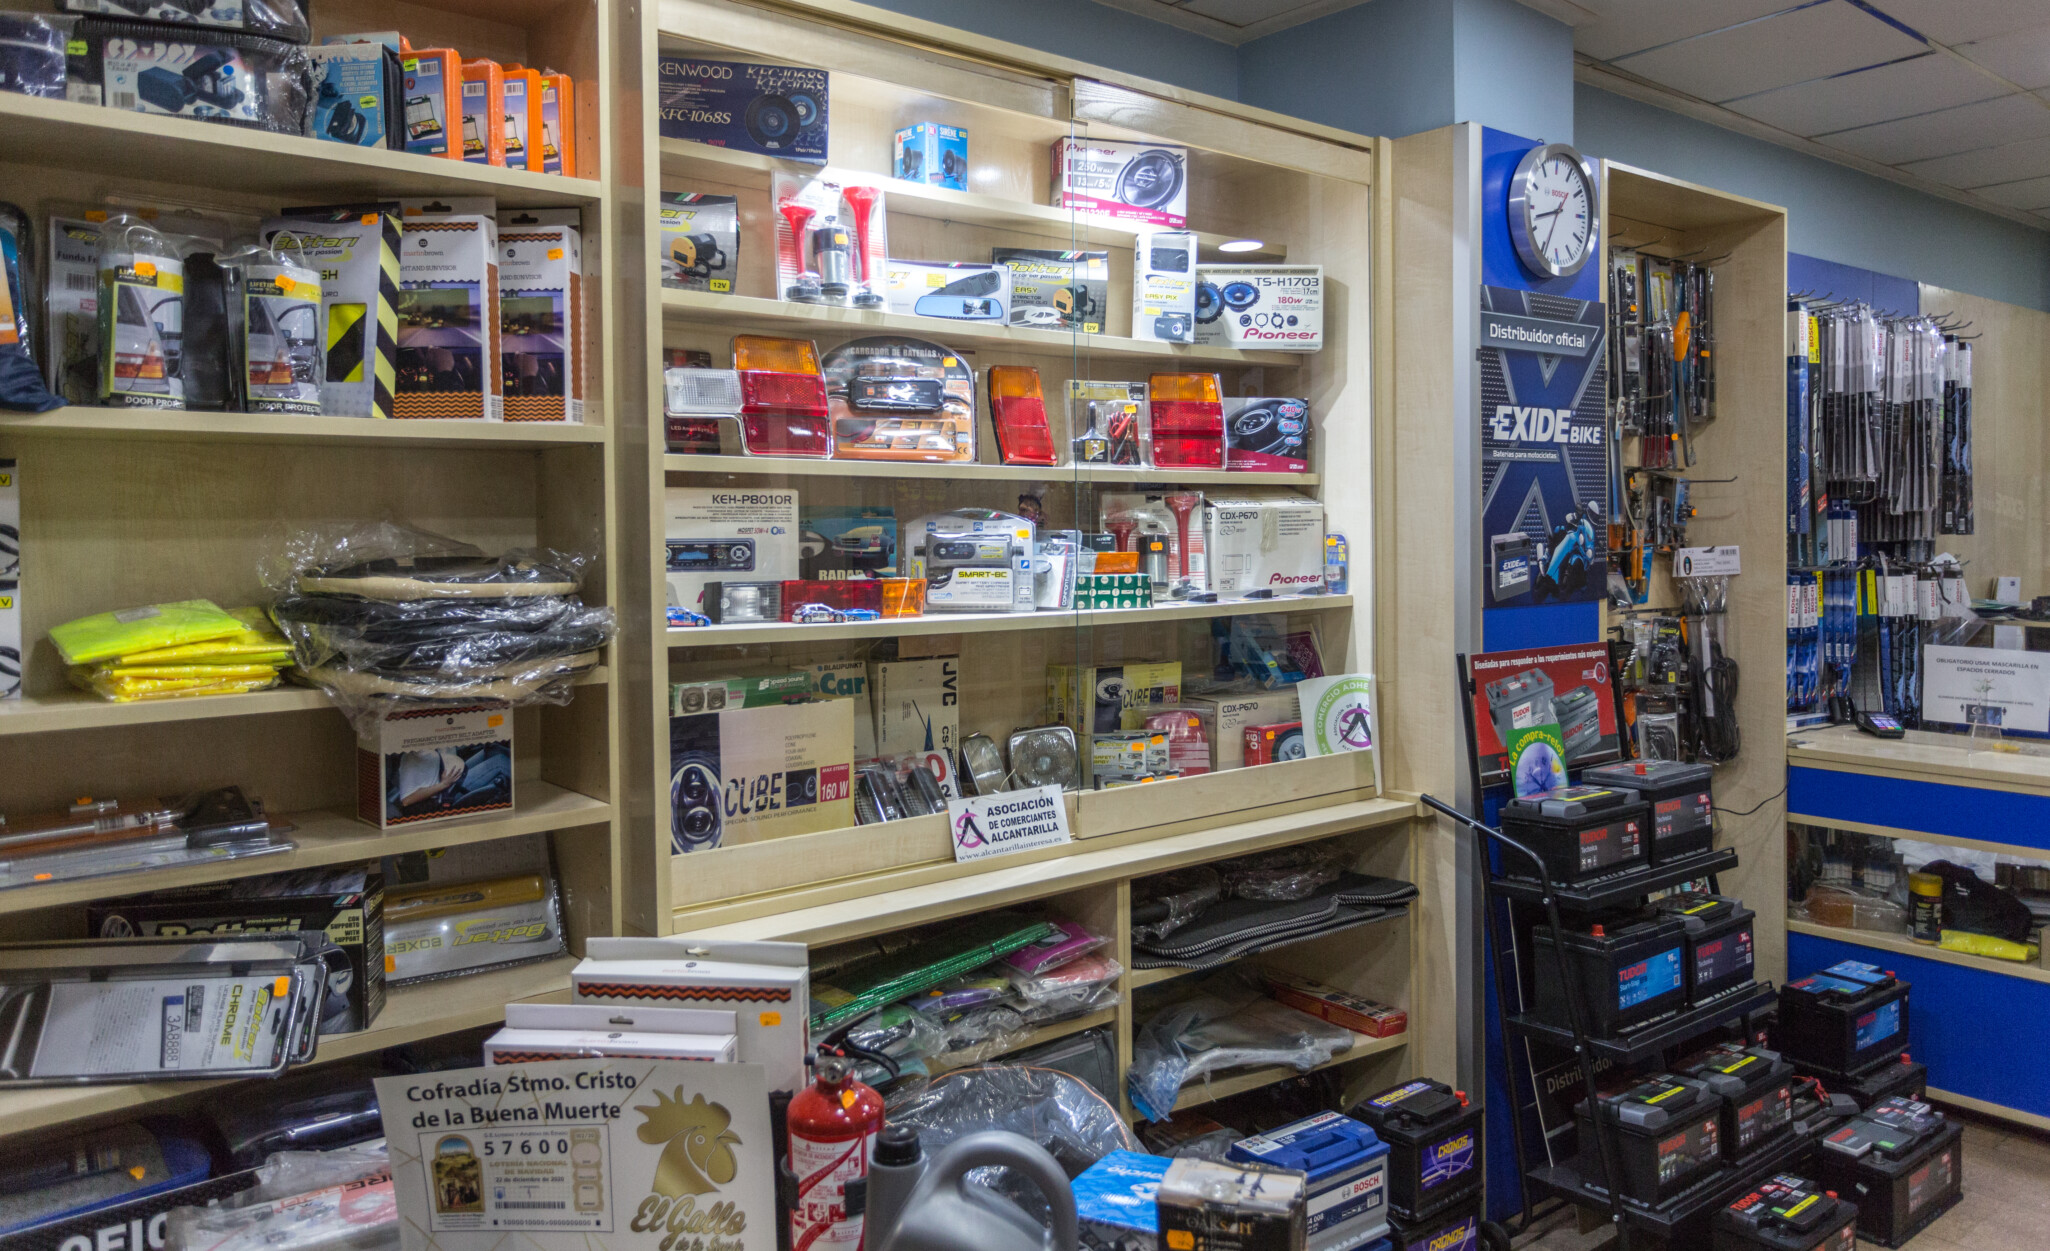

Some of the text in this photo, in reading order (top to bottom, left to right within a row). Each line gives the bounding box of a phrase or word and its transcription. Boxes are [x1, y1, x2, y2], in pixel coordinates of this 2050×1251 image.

[659, 62, 733, 80] KENWOOD
[746, 66, 827, 84] KFC-1068S
[659, 108, 732, 124] KFC-1068S
[275, 235, 359, 249] Bottari
[57, 252, 85, 263] Funda
[1254, 277, 1319, 287] TS-H1703
[1243, 328, 1318, 339] Pioneer
[1489, 323, 1585, 348] Distribuidor oficial
[850, 347, 890, 356] CARGADOR
[125, 396, 153, 406] DOOR
[259, 402, 282, 411] DOOR
[1489, 405, 1600, 444] EXIDE BIKE
[1527, 451, 1557, 459] motocicletas
[712, 495, 792, 505] KEH-P8010R
[1220, 512, 1258, 520] CDX-P670
[1503, 560, 1520, 570] EXIDE
[1269, 573, 1322, 585] Pioneer
[824, 663, 863, 671] BLAUPUNKT
[1474, 660, 1499, 670] Diseñadas
[1500, 659, 1510, 668] para
[1510, 656, 1533, 666] responder
[1545, 652, 1577, 663] requerimientos
[1578, 651, 1586, 659] más
[1586, 650, 1606, 659] exigentes
[820, 673, 865, 695] Car
[943, 662, 957, 706] JVC
[1123, 687, 1149, 708] CUBE
[1222, 702, 1258, 713] CDX-P670
[1317, 688, 1341, 736] COMERCIO
[1513, 706, 1530, 718] TUDOR
[404, 736, 437, 744] PREGNANCY
[1563, 723, 1583, 740] TUDOR
[1509, 754, 1518, 766] La
[1516, 730, 1565, 757] compra-reloj
[724, 772, 783, 817] CUBE
[822, 780, 849, 800] 160 W
[774, 807, 817, 818] PERFORMANCE
[987, 796, 1054, 817] ASOCIACIÓN
[1655, 800, 1681, 814] TUDOR
[989, 810, 1057, 830] DE COMERCIANTES
[991, 822, 1059, 843] ALCANTARILLA
[1580, 828, 1608, 845] TUDOR
[959, 837, 1062, 861] www.alcantarillainteresa.es
[453, 923, 546, 947] Bottari
[386, 937, 442, 954] BOXER
[1698, 941, 1723, 959] TUDOR
[1619, 963, 1647, 982] TUDOR
[221, 984, 243, 1045] CHROME
[244, 987, 268, 1062] Bottari
[407, 1072, 637, 1102] Cofradía Stmo. Cristo
[1373, 1088, 1409, 1105] CRONOS
[412, 1102, 621, 1128] de la Buena Muerte
[1312, 1113, 1336, 1124] BOSCH
[1438, 1135, 1468, 1159] CRONOS
[1353, 1176, 1379, 1193] BOSCH
[630, 1195, 747, 1251] El Gallo
[1313, 1214, 1324, 1222] 008
[1429, 1226, 1465, 1251] CRONOS
